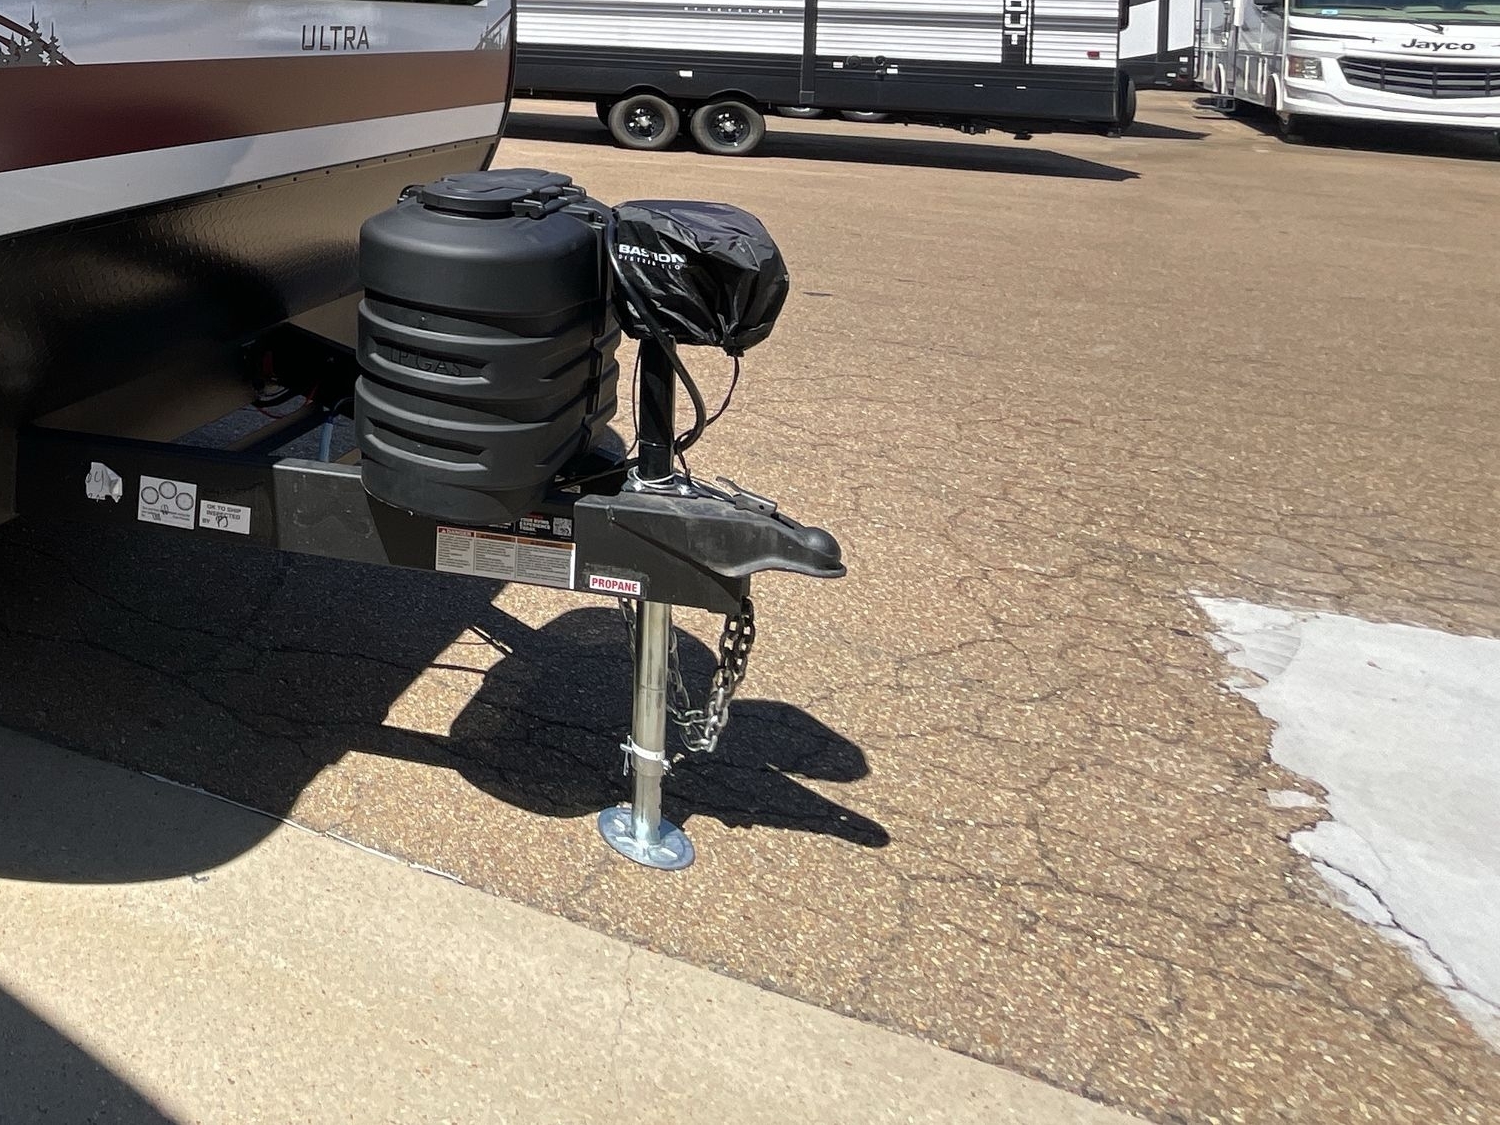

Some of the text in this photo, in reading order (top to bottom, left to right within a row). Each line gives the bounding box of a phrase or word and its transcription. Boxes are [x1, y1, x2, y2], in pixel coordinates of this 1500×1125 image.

[301, 25, 370, 51] ULTRA
[1401, 38, 1476, 52] Jayco
[416, 355, 461, 376] GAS
[591, 577, 638, 593] PROPANE
